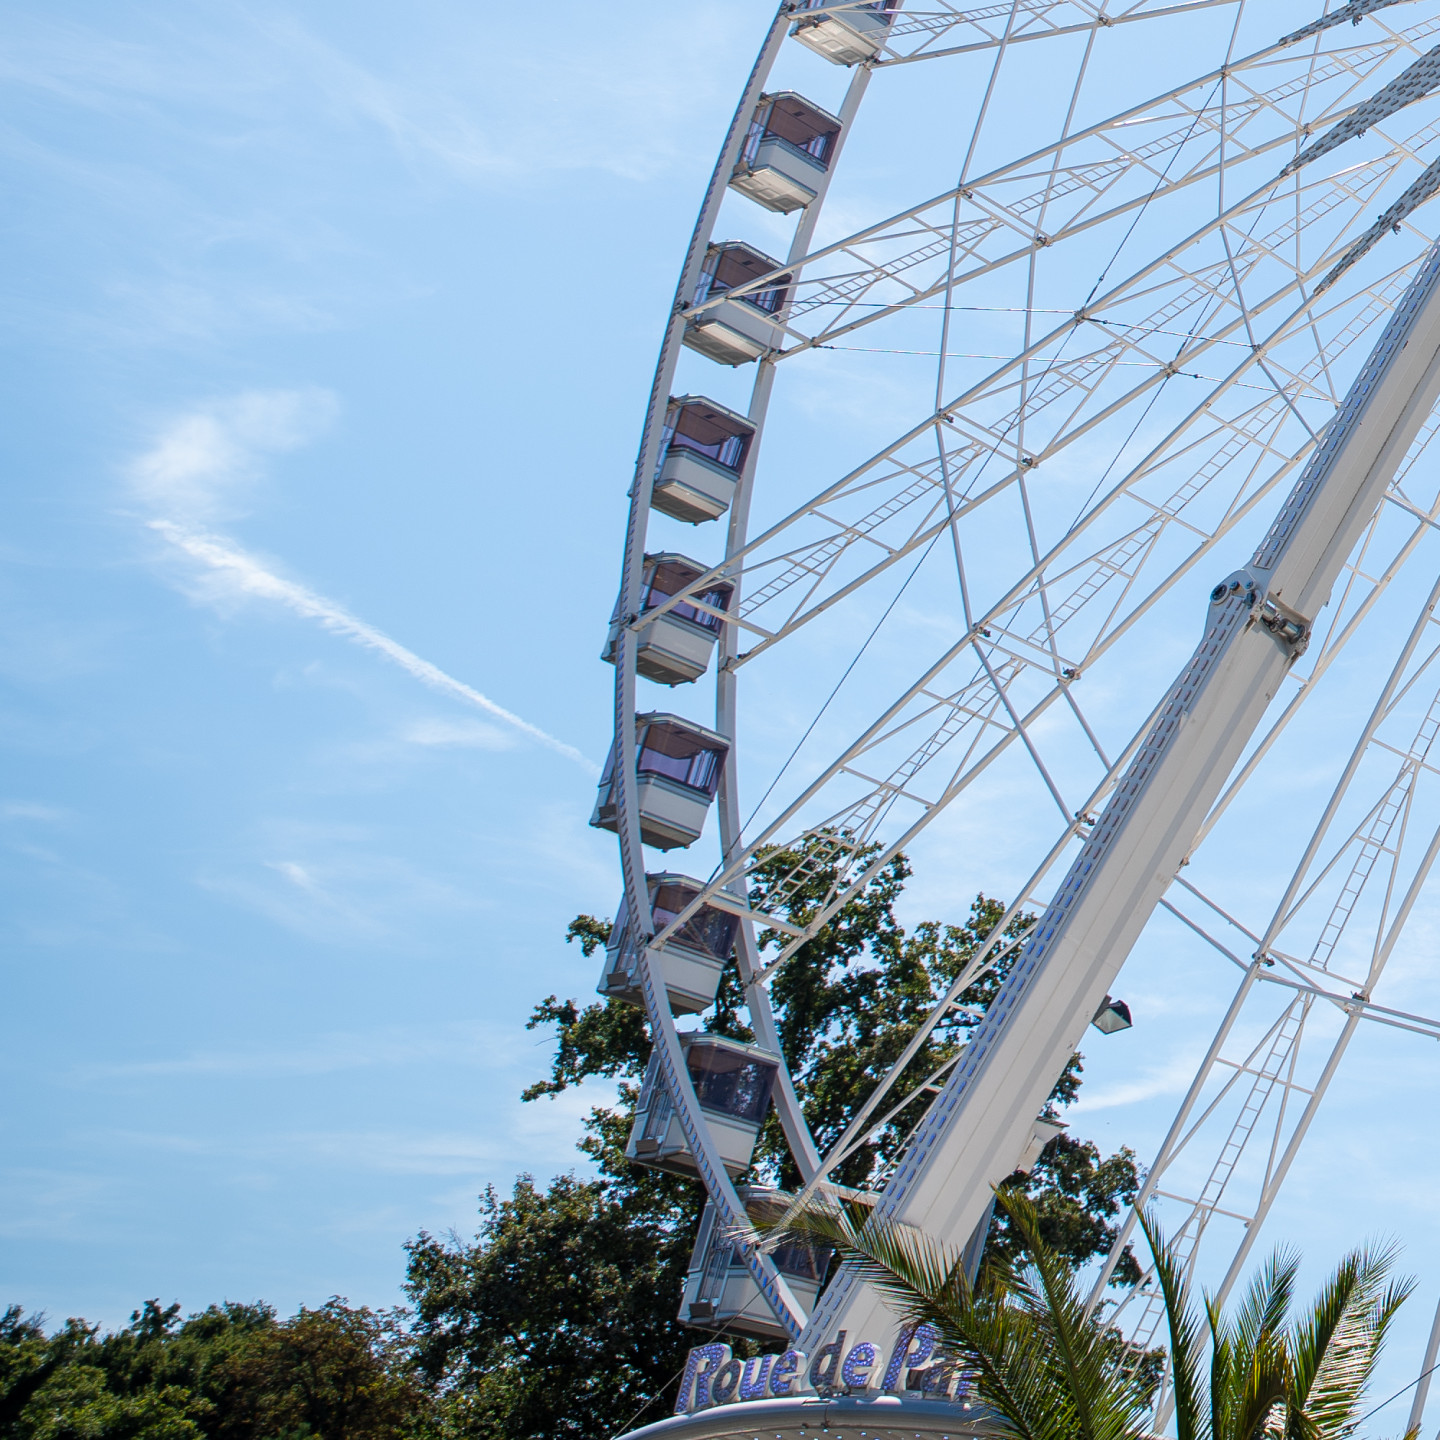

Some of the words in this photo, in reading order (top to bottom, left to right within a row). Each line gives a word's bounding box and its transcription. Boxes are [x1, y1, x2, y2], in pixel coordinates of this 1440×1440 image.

[674, 1342, 803, 1414] Roue
[809, 1329, 880, 1392] de
[882, 1323, 988, 1397] Par
